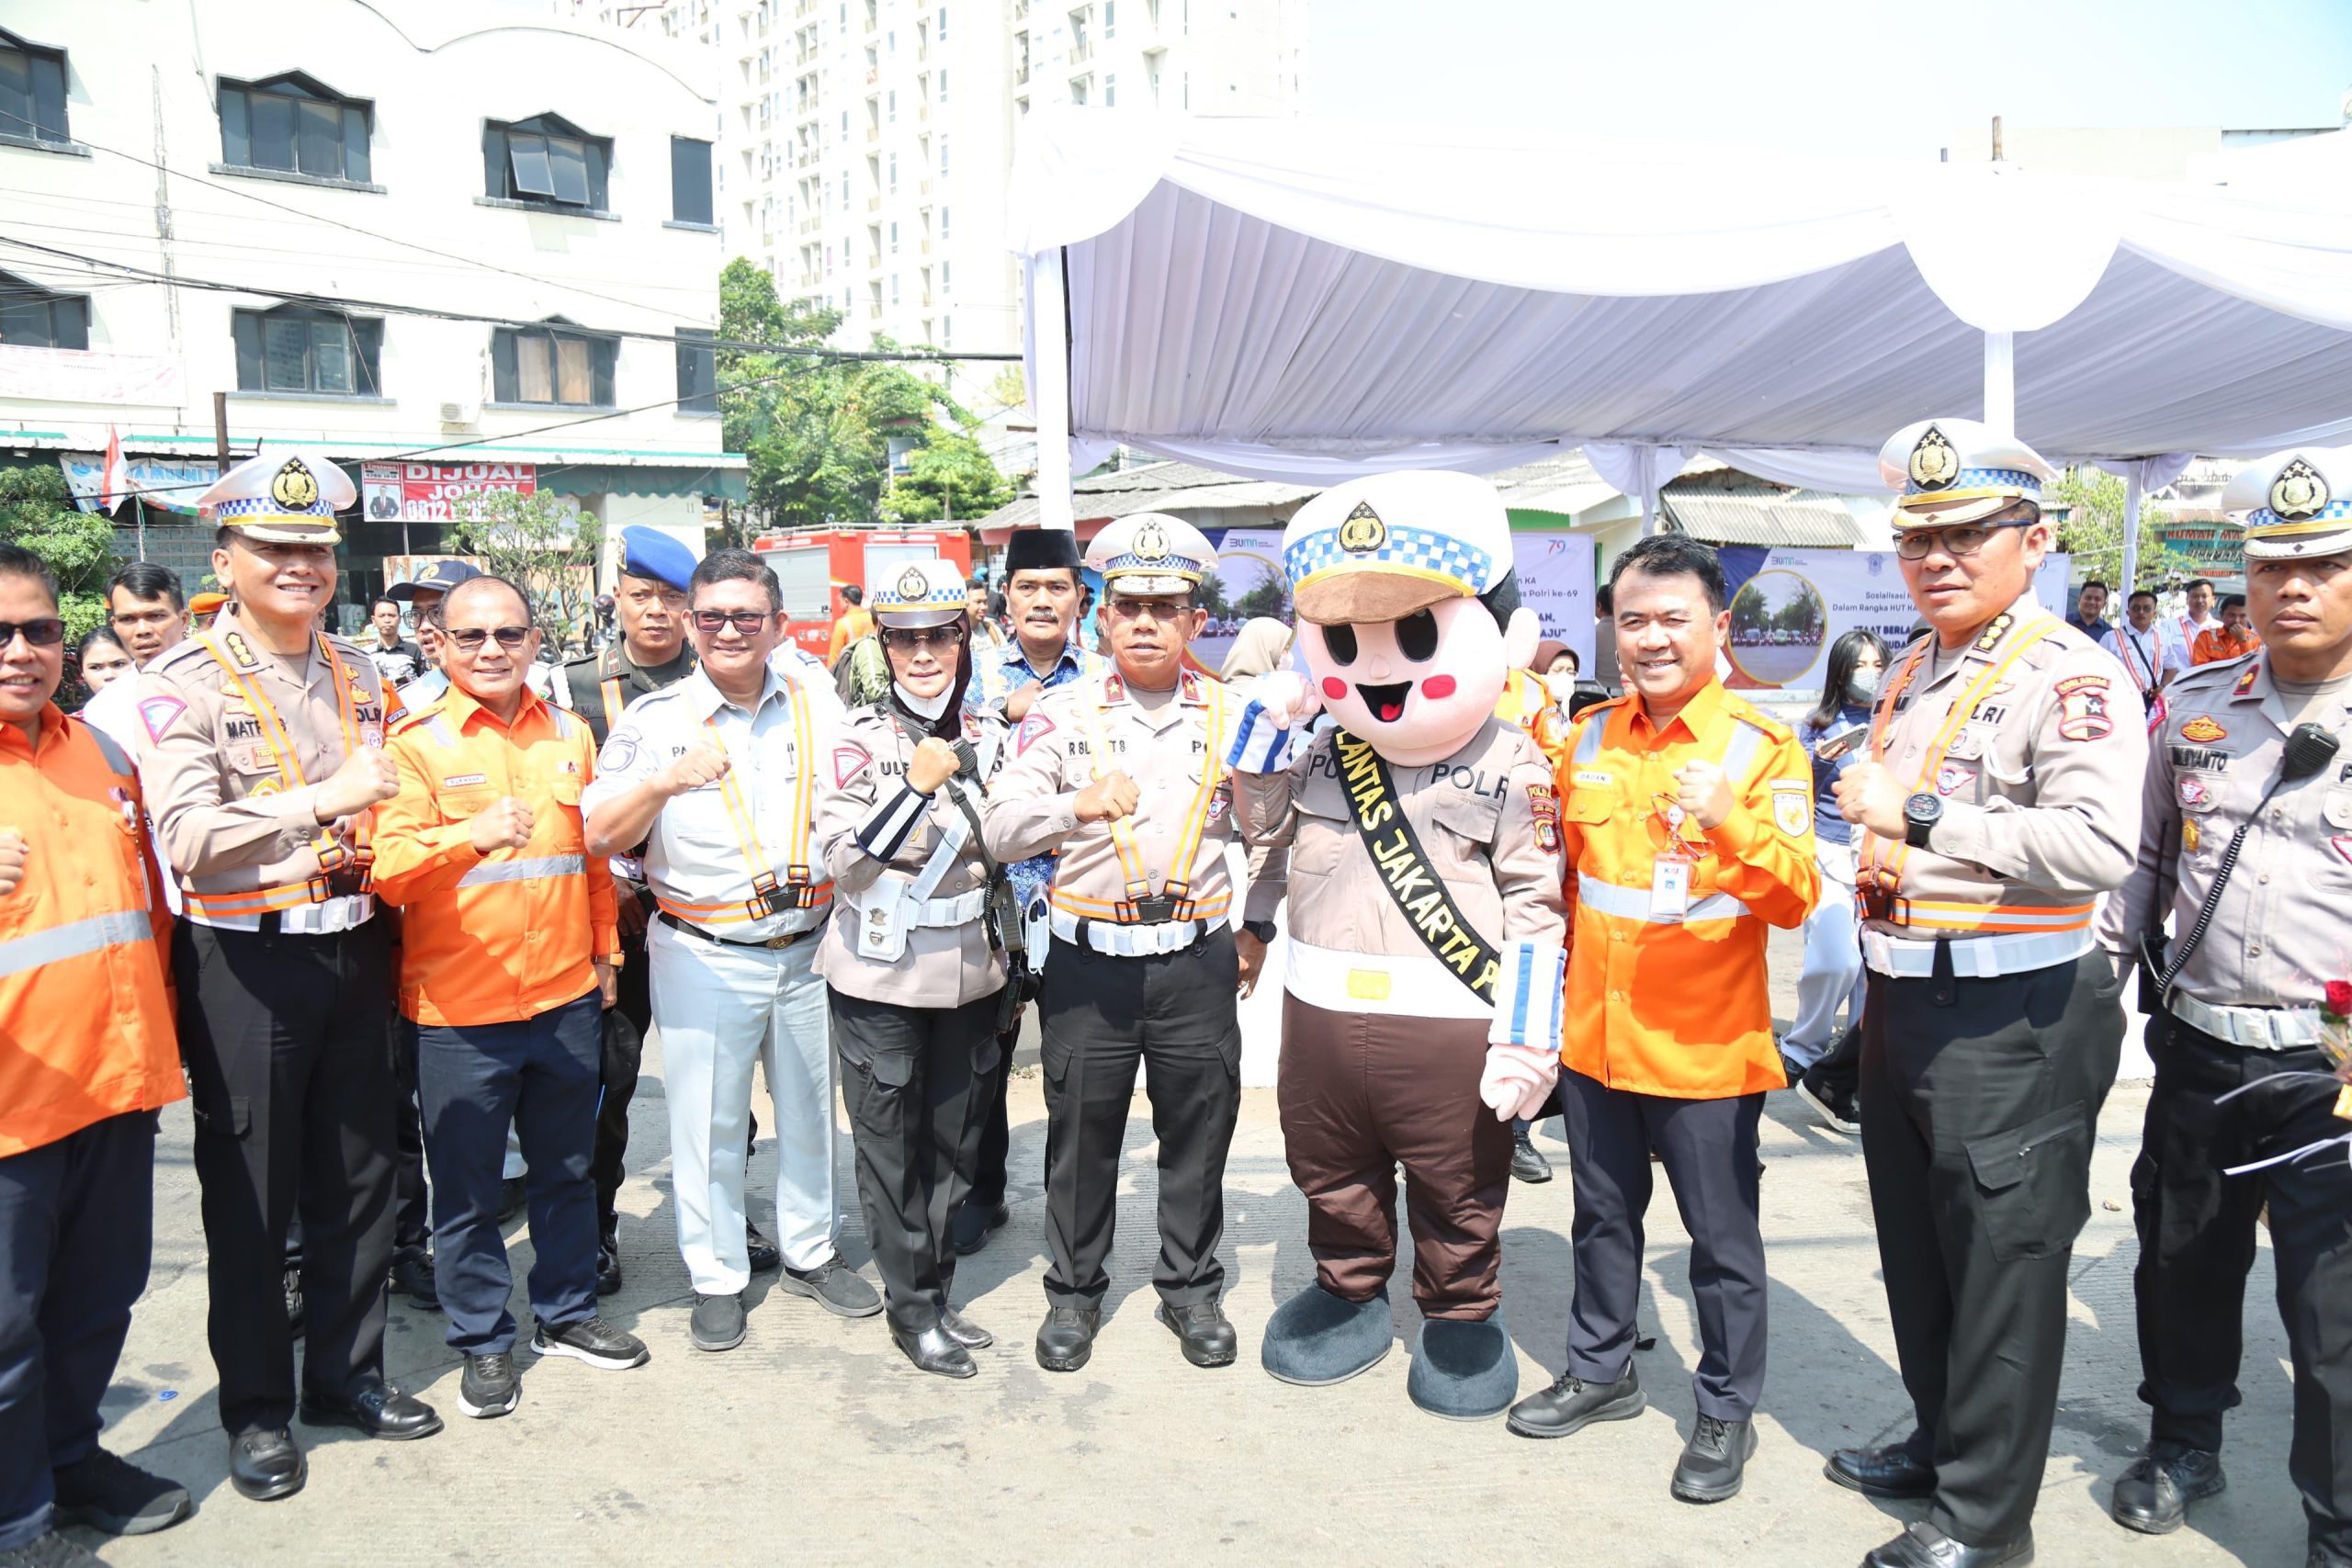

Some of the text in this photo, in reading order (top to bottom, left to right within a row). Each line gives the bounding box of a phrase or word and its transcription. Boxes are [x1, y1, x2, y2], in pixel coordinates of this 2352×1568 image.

[406, 464, 533, 480] DIJUAL
[2166, 529, 2241, 539] RUMAH MA
[1548, 539, 1566, 555] 79
[1529, 589, 1550, 597] Polri
[1553, 589, 1578, 597] ke-69
[1865, 592, 1906, 600] Sosialisasi
[1832, 604, 1918, 614] Dalam Rangka HUT KA
[1538, 613, 1555, 623] AN,
[1540, 628, 1566, 637] AJU"
[1883, 626, 1911, 635] BERLA
[1308, 754, 1338, 779] PO
[1430, 763, 1509, 800] POLR
[1373, 828, 1481, 976] JAKARTA
